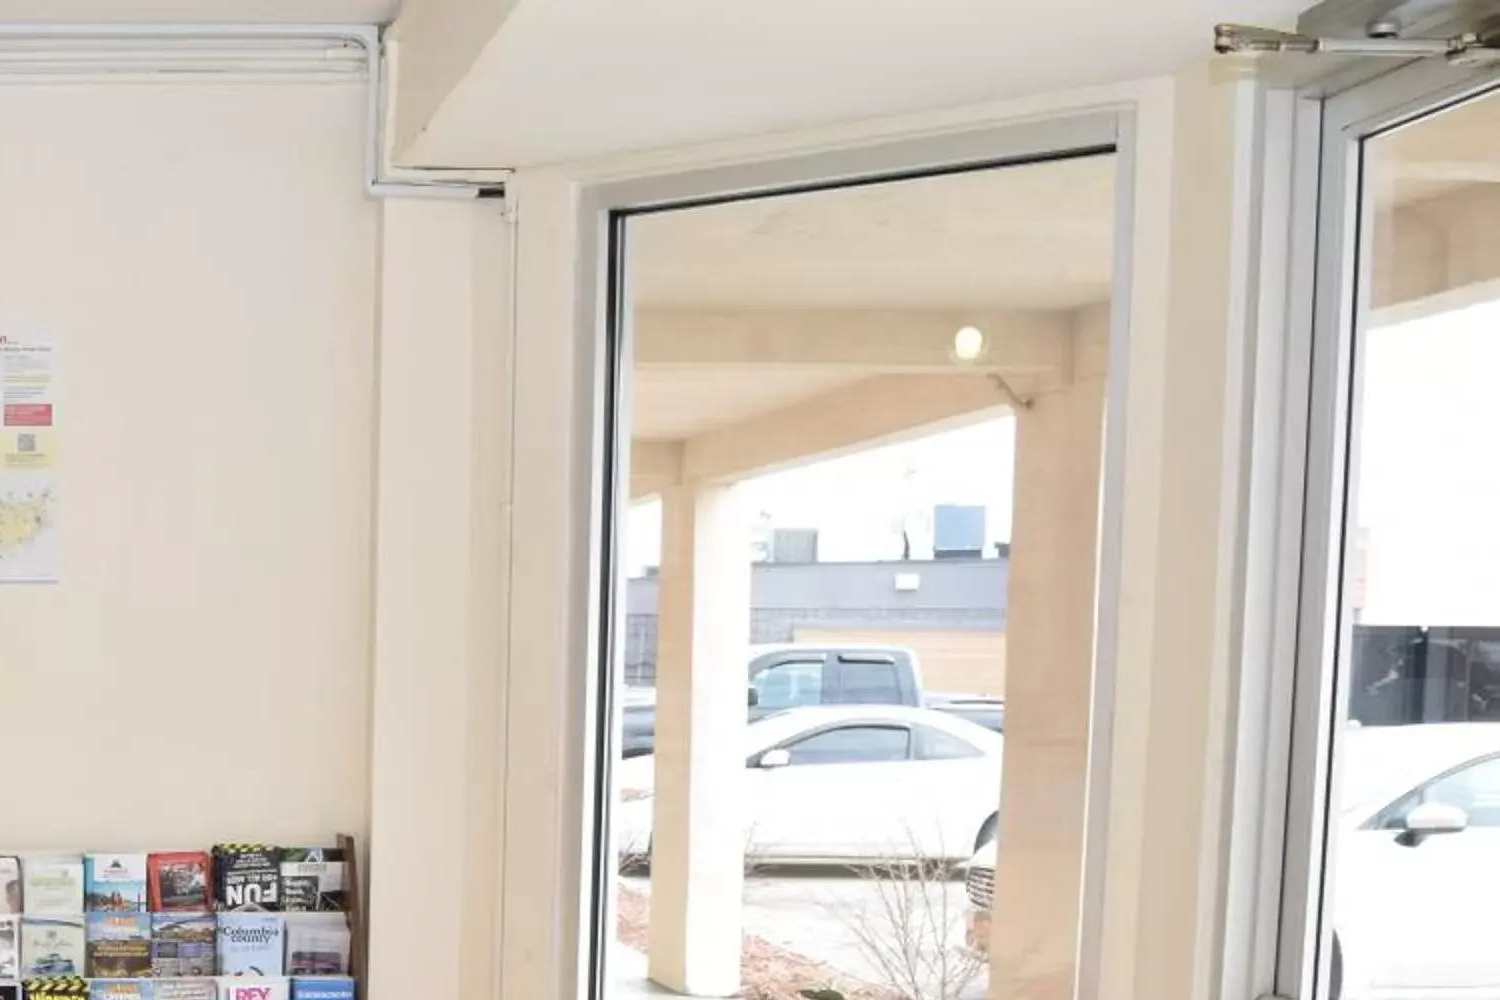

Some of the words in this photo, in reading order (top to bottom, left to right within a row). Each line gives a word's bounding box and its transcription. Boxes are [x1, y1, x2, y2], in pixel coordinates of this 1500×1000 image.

[226, 883, 278, 905] FUN
[221, 926, 279, 937] Columbia
[230, 934, 272, 945] county
